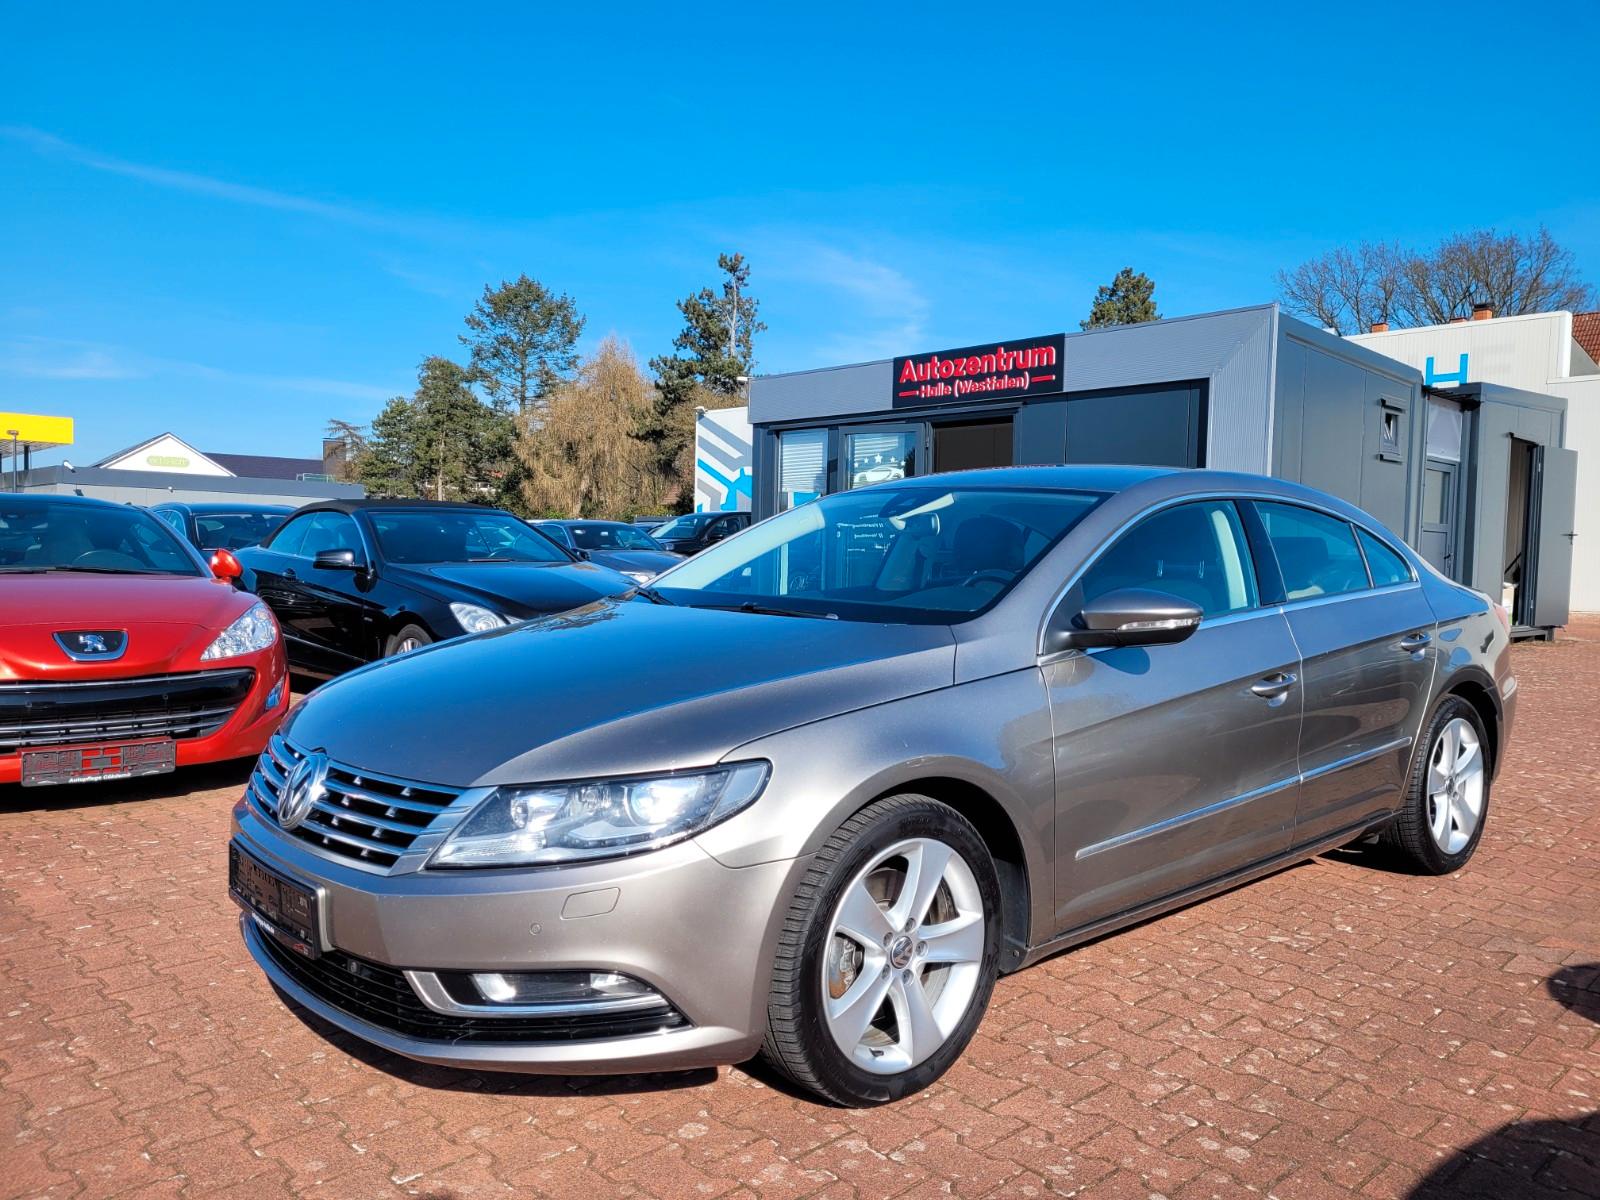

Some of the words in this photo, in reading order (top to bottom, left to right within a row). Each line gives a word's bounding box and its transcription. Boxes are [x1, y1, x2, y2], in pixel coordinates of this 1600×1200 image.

[900, 346, 1056, 383] Autozentrum
[921, 380, 952, 398] Halle
[954, 371, 1030, 398] (Westfalen)
